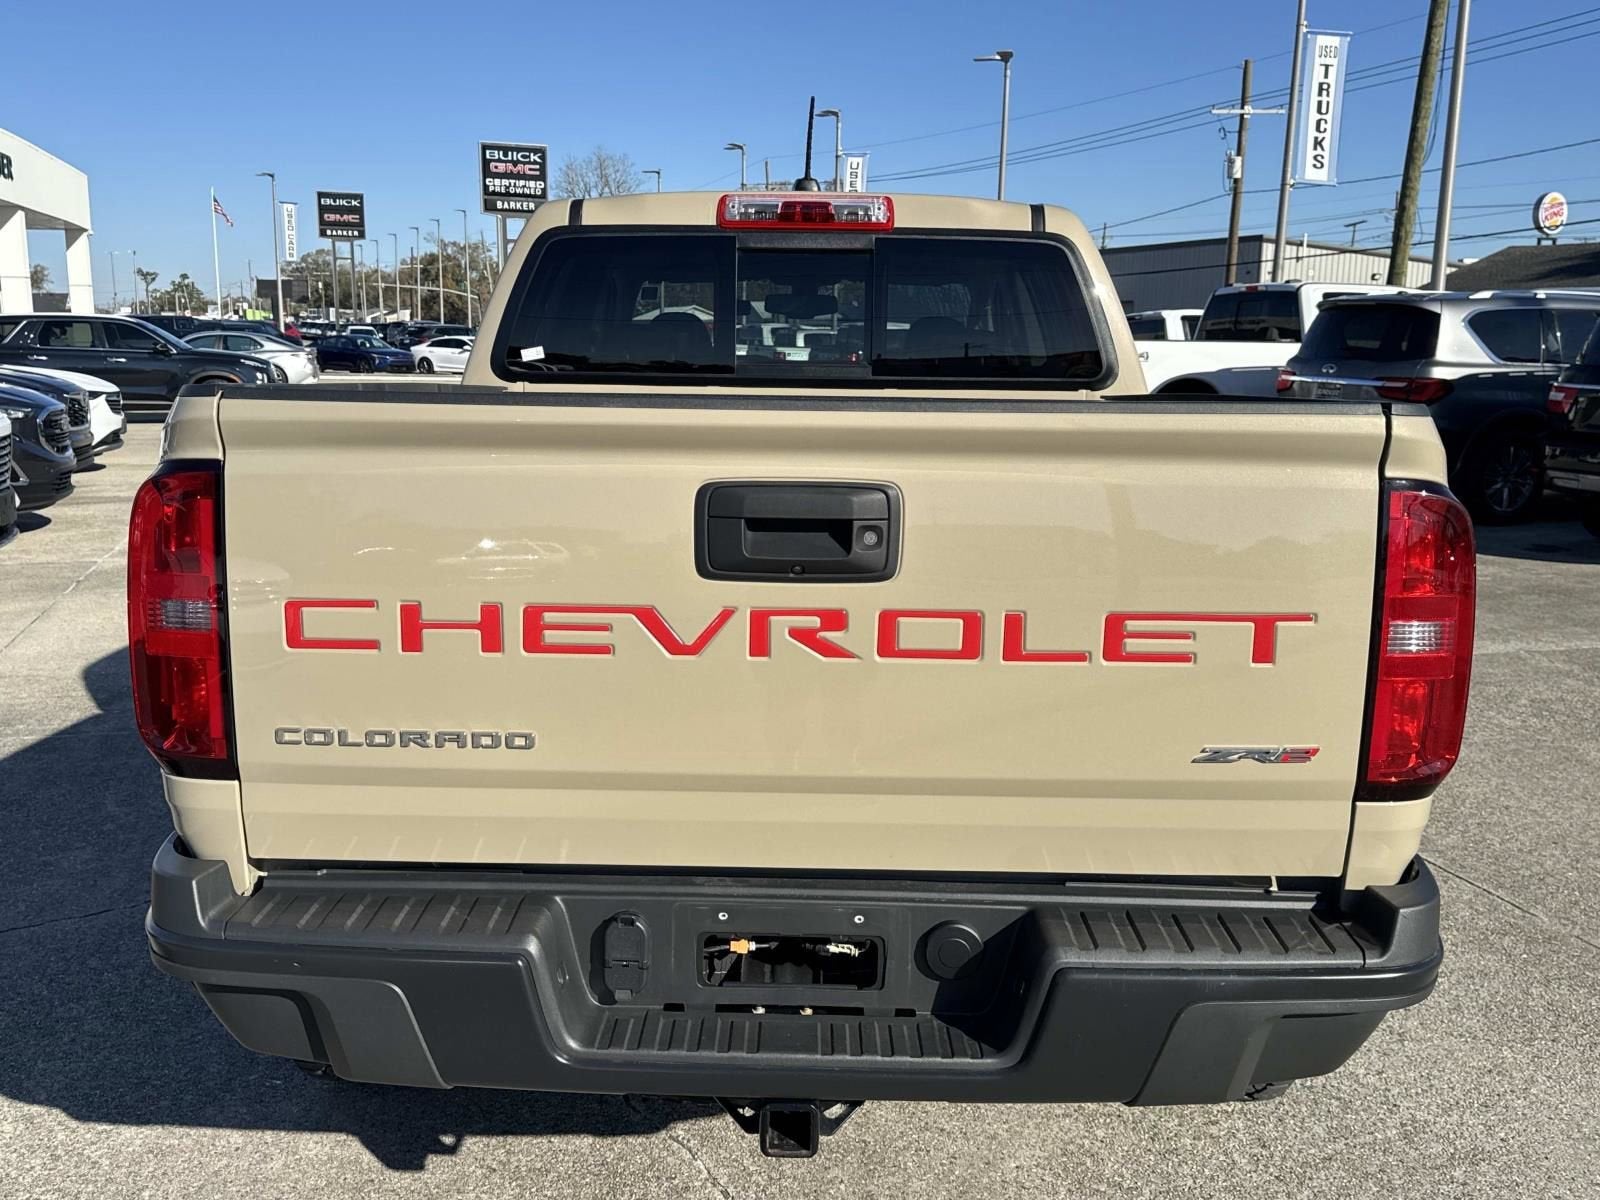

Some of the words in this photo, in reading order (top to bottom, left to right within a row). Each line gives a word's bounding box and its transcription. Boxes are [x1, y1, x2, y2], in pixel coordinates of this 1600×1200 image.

[1318, 45, 1338, 59] USED
[1312, 63, 1334, 169] TRUCKS
[485, 149, 543, 162] BUICK
[489, 161, 540, 175] GMC
[485, 178, 545, 189] CERTIFIED
[489, 186, 542, 195] PRE-OWNED
[320, 198, 361, 207] BUICK
[496, 200, 536, 211] BARKER
[286, 206, 294, 231] USED
[323, 213, 360, 223] GMC
[326, 229, 359, 237] BARKER
[284, 597, 1317, 669] CHEVROLET
[273, 726, 537, 750] COLORADO
[1190, 745, 1321, 764] ZR2
